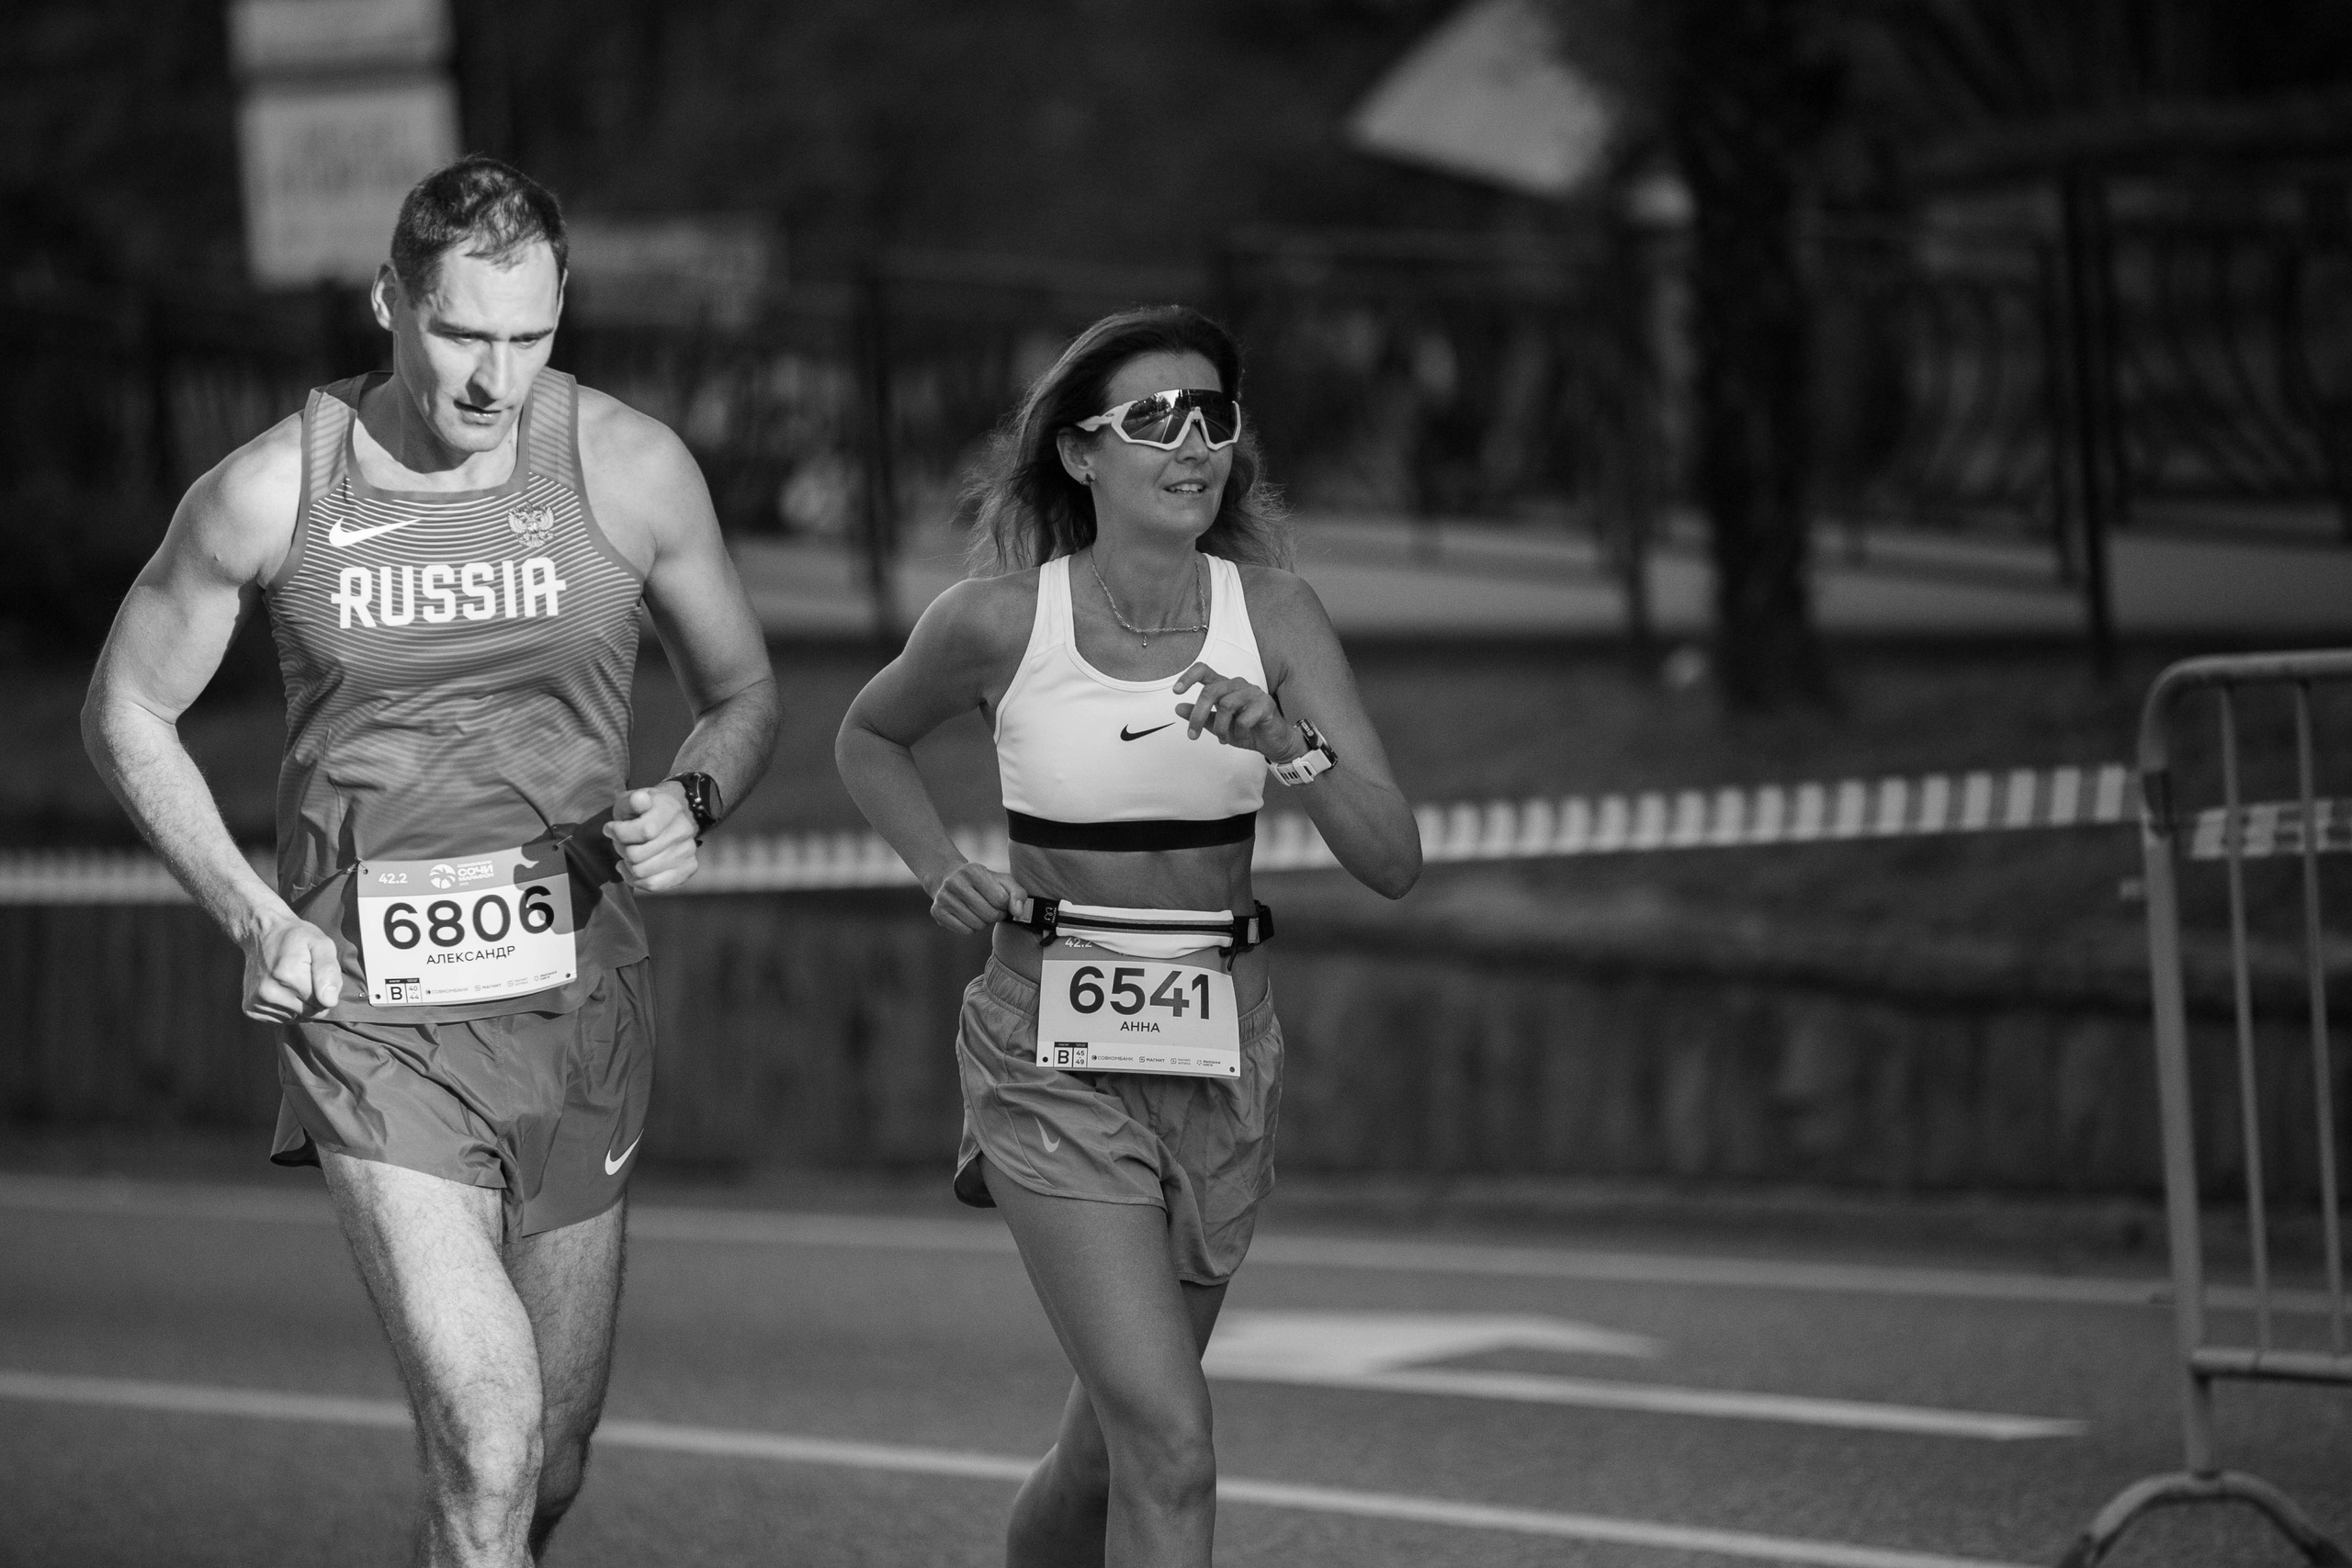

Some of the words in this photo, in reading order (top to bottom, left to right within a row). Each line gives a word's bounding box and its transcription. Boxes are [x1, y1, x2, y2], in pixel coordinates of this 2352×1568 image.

[331, 557, 566, 628] RUSSIA
[379, 873, 408, 884] 42.2
[458, 864, 493, 876] СОЧИ
[383, 885, 555, 950] 6806
[426, 945, 515, 964] АЛЕКСАНДР
[1069, 965, 1209, 1020] 6541
[1120, 1021, 1160, 1032] АННА
